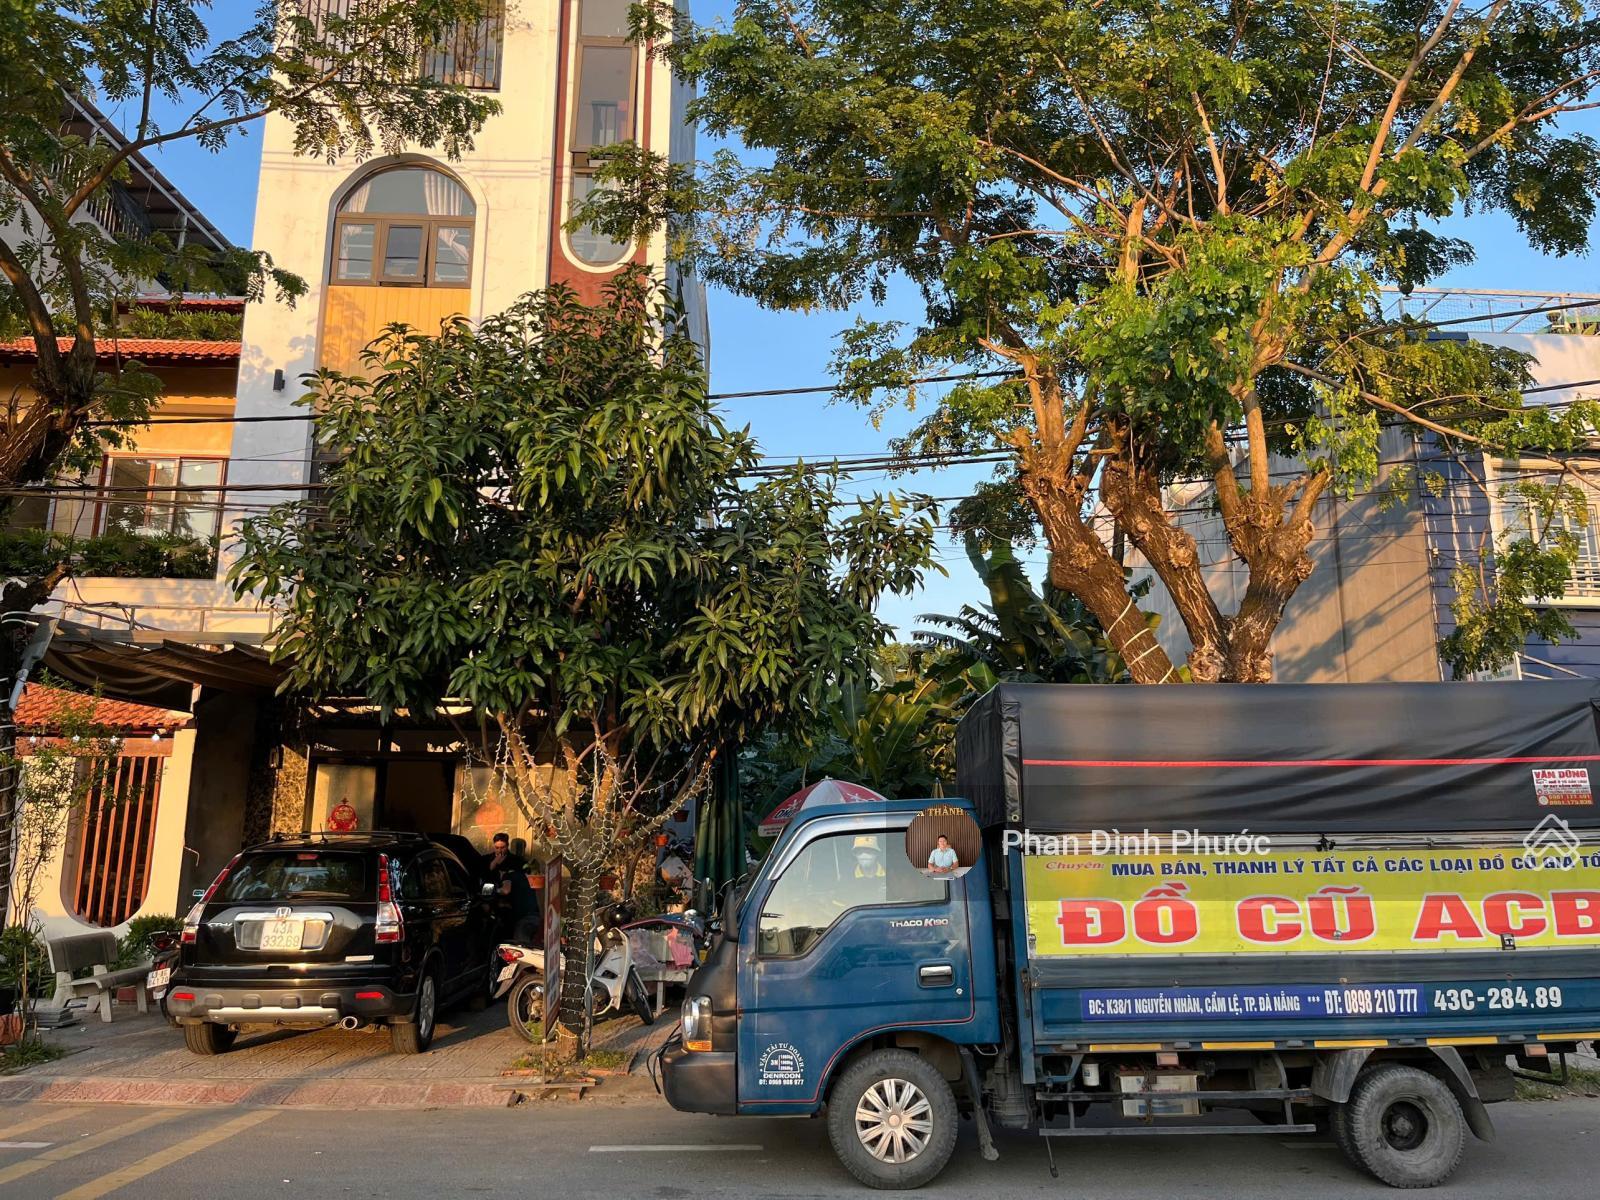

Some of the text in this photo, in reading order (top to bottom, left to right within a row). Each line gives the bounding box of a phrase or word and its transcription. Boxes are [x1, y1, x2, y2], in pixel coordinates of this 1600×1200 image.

[1045, 861, 1105, 871] Chuyên:
[1111, 863, 1154, 876] MUA
[1160, 860, 1208, 877] BÁN,
[1213, 861, 1277, 874] THANH
[1283, 858, 1305, 873] LÝ
[1311, 856, 1346, 873] TẤT
[1352, 856, 1379, 872] CẢ
[1384, 857, 1424, 872] CÁC
[1430, 858, 1473, 873] LOẠI
[1478, 853, 1505, 870] ĐỒ
[1511, 854, 1537, 870] CŨ
[889, 919, 923, 928] THACO
[1056, 882, 1600, 945] ĐỒ CŨ ACB
[1088, 999, 1105, 1015] ĐC:
[1106, 998, 1132, 1014] K38/1
[1134, 992, 1172, 1014] NGUYỄN
[1173, 994, 1203, 1015] NHÀN,
[1228, 993, 1243, 1015] LỆ,
[1243, 996, 1258, 1012] TP.
[1258, 993, 1273, 1012] ĐÀ
[1324, 990, 1343, 1014] ĐT:
[1343, 989, 1373, 1014] 0898
[1374, 989, 1396, 1013] 210
[1396, 988, 1418, 1013] 777
[1433, 986, 1562, 1011] 43C-284.89
